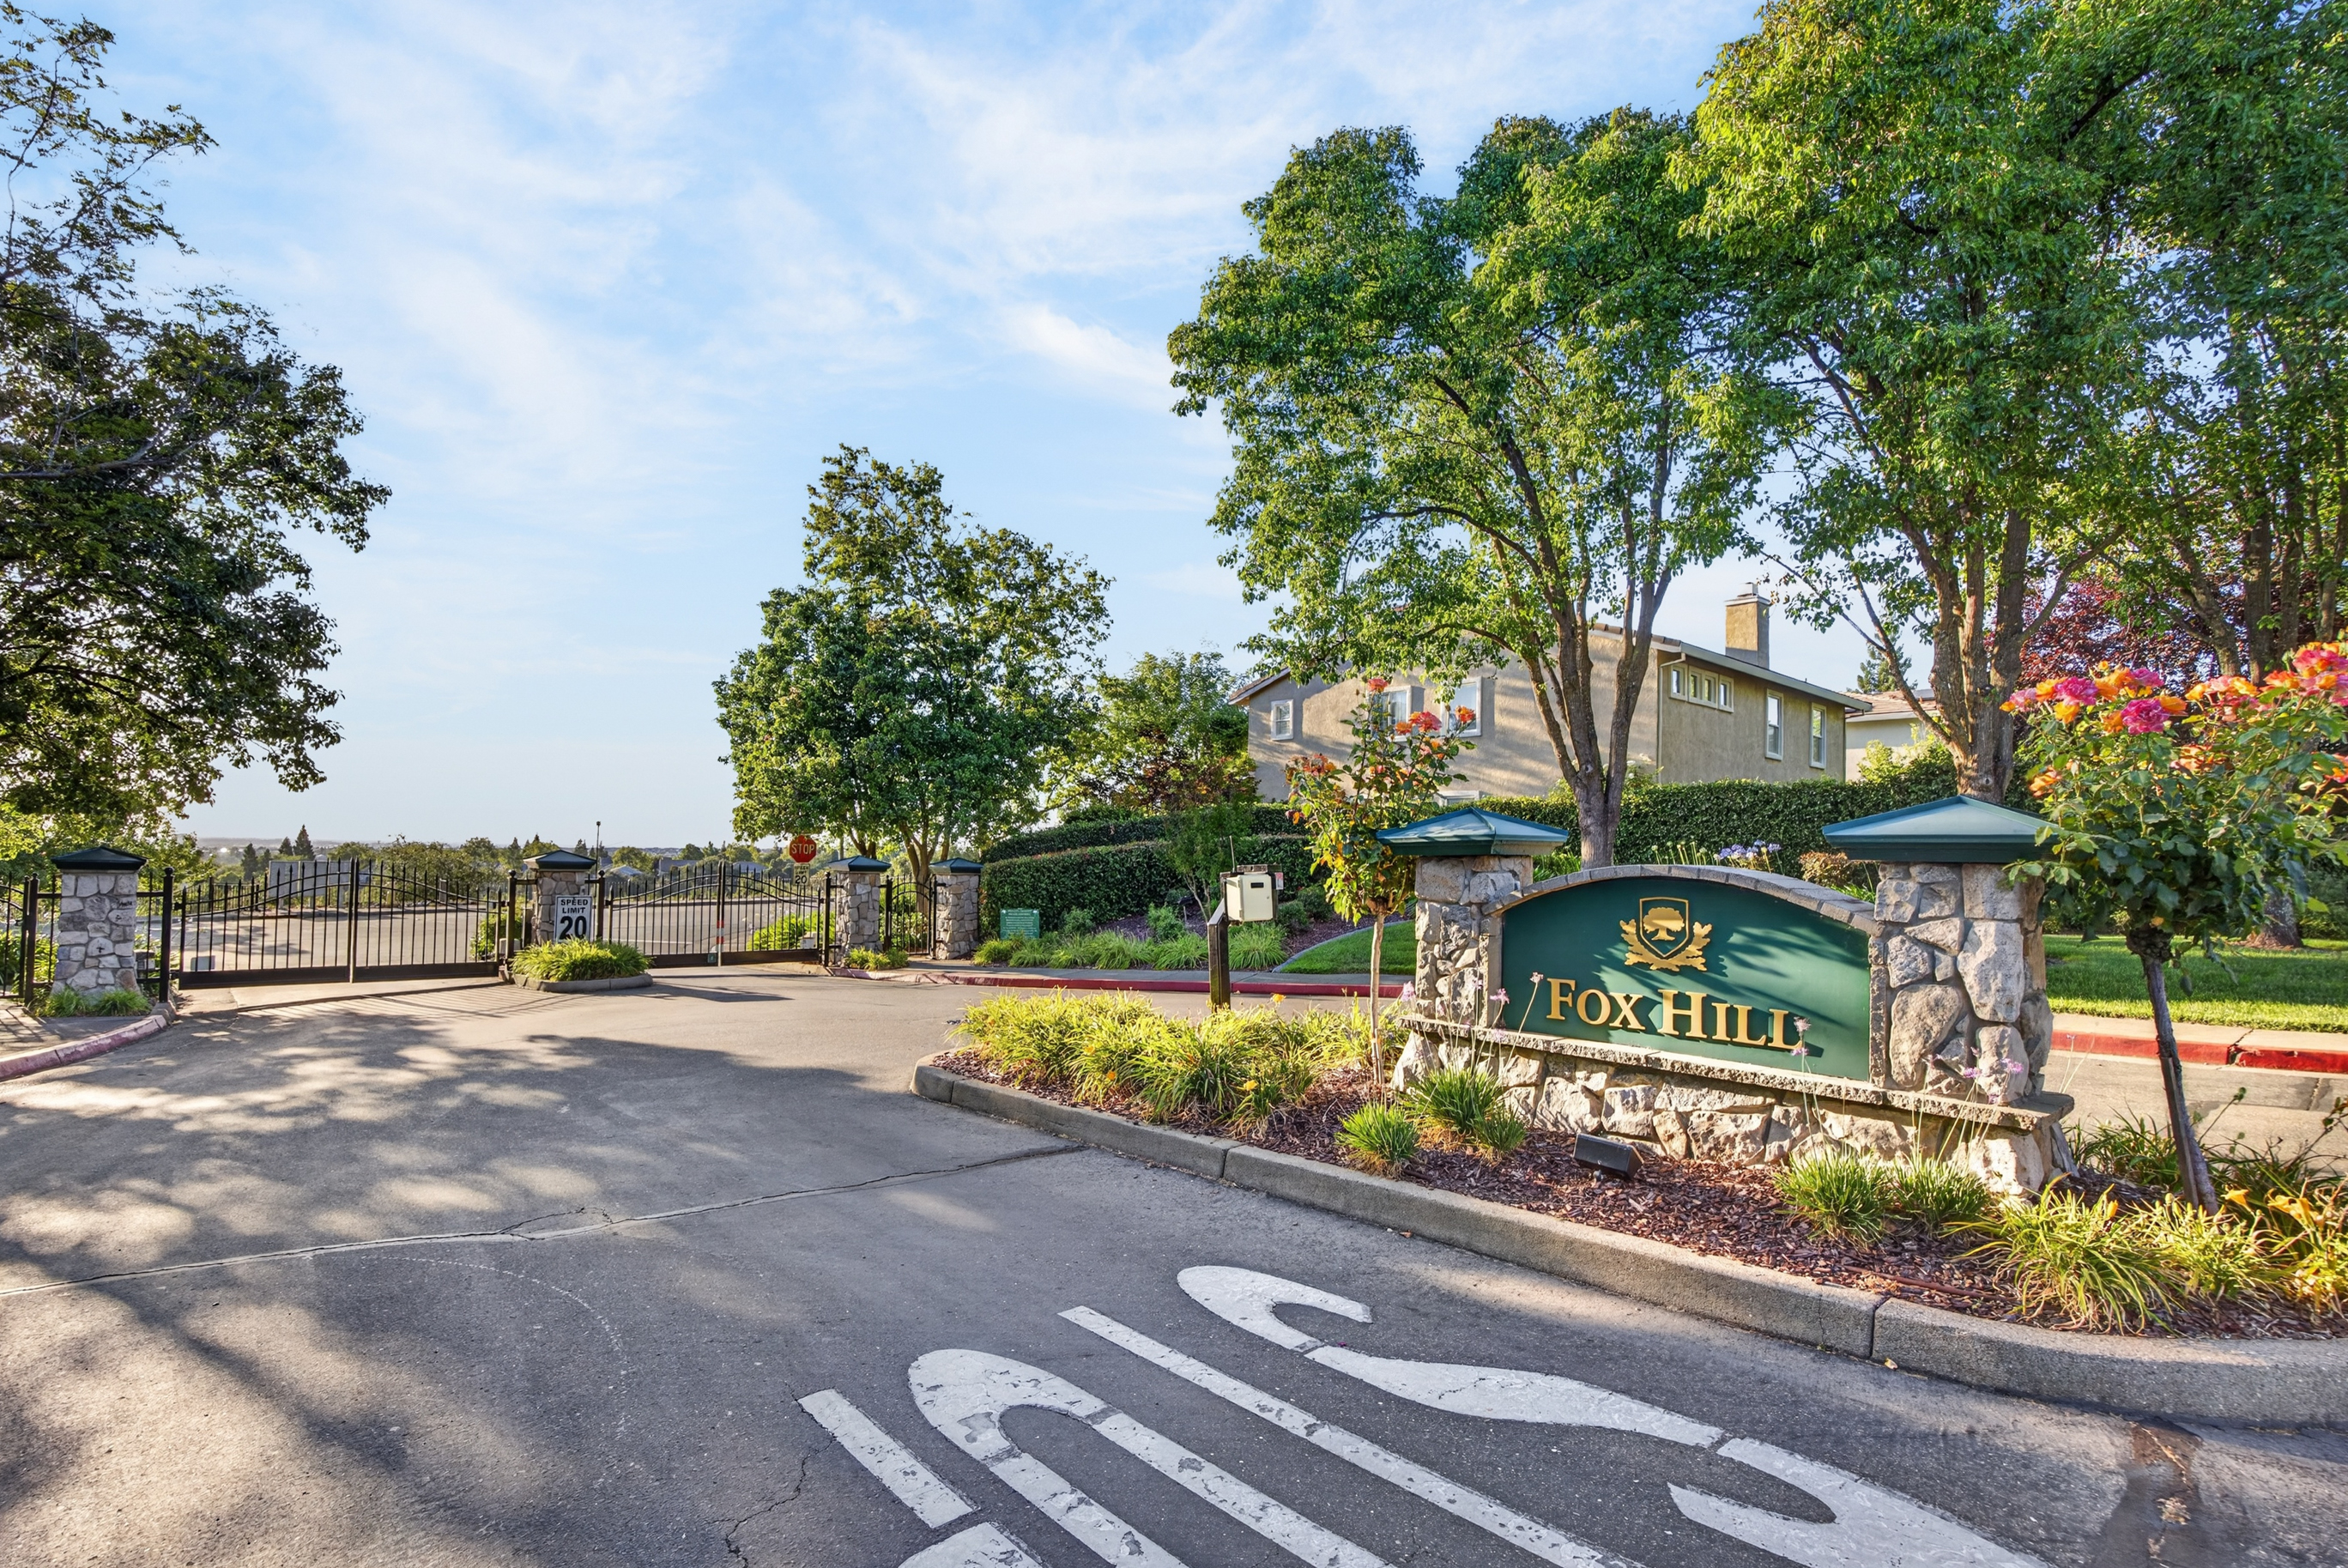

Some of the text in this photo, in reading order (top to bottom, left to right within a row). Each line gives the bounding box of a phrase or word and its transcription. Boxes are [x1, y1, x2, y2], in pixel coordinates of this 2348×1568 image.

[791, 844, 814, 854] STOP
[795, 875, 808, 884] 20
[559, 915, 587, 940] 20
[1546, 978, 1802, 1050] FOX HILL
